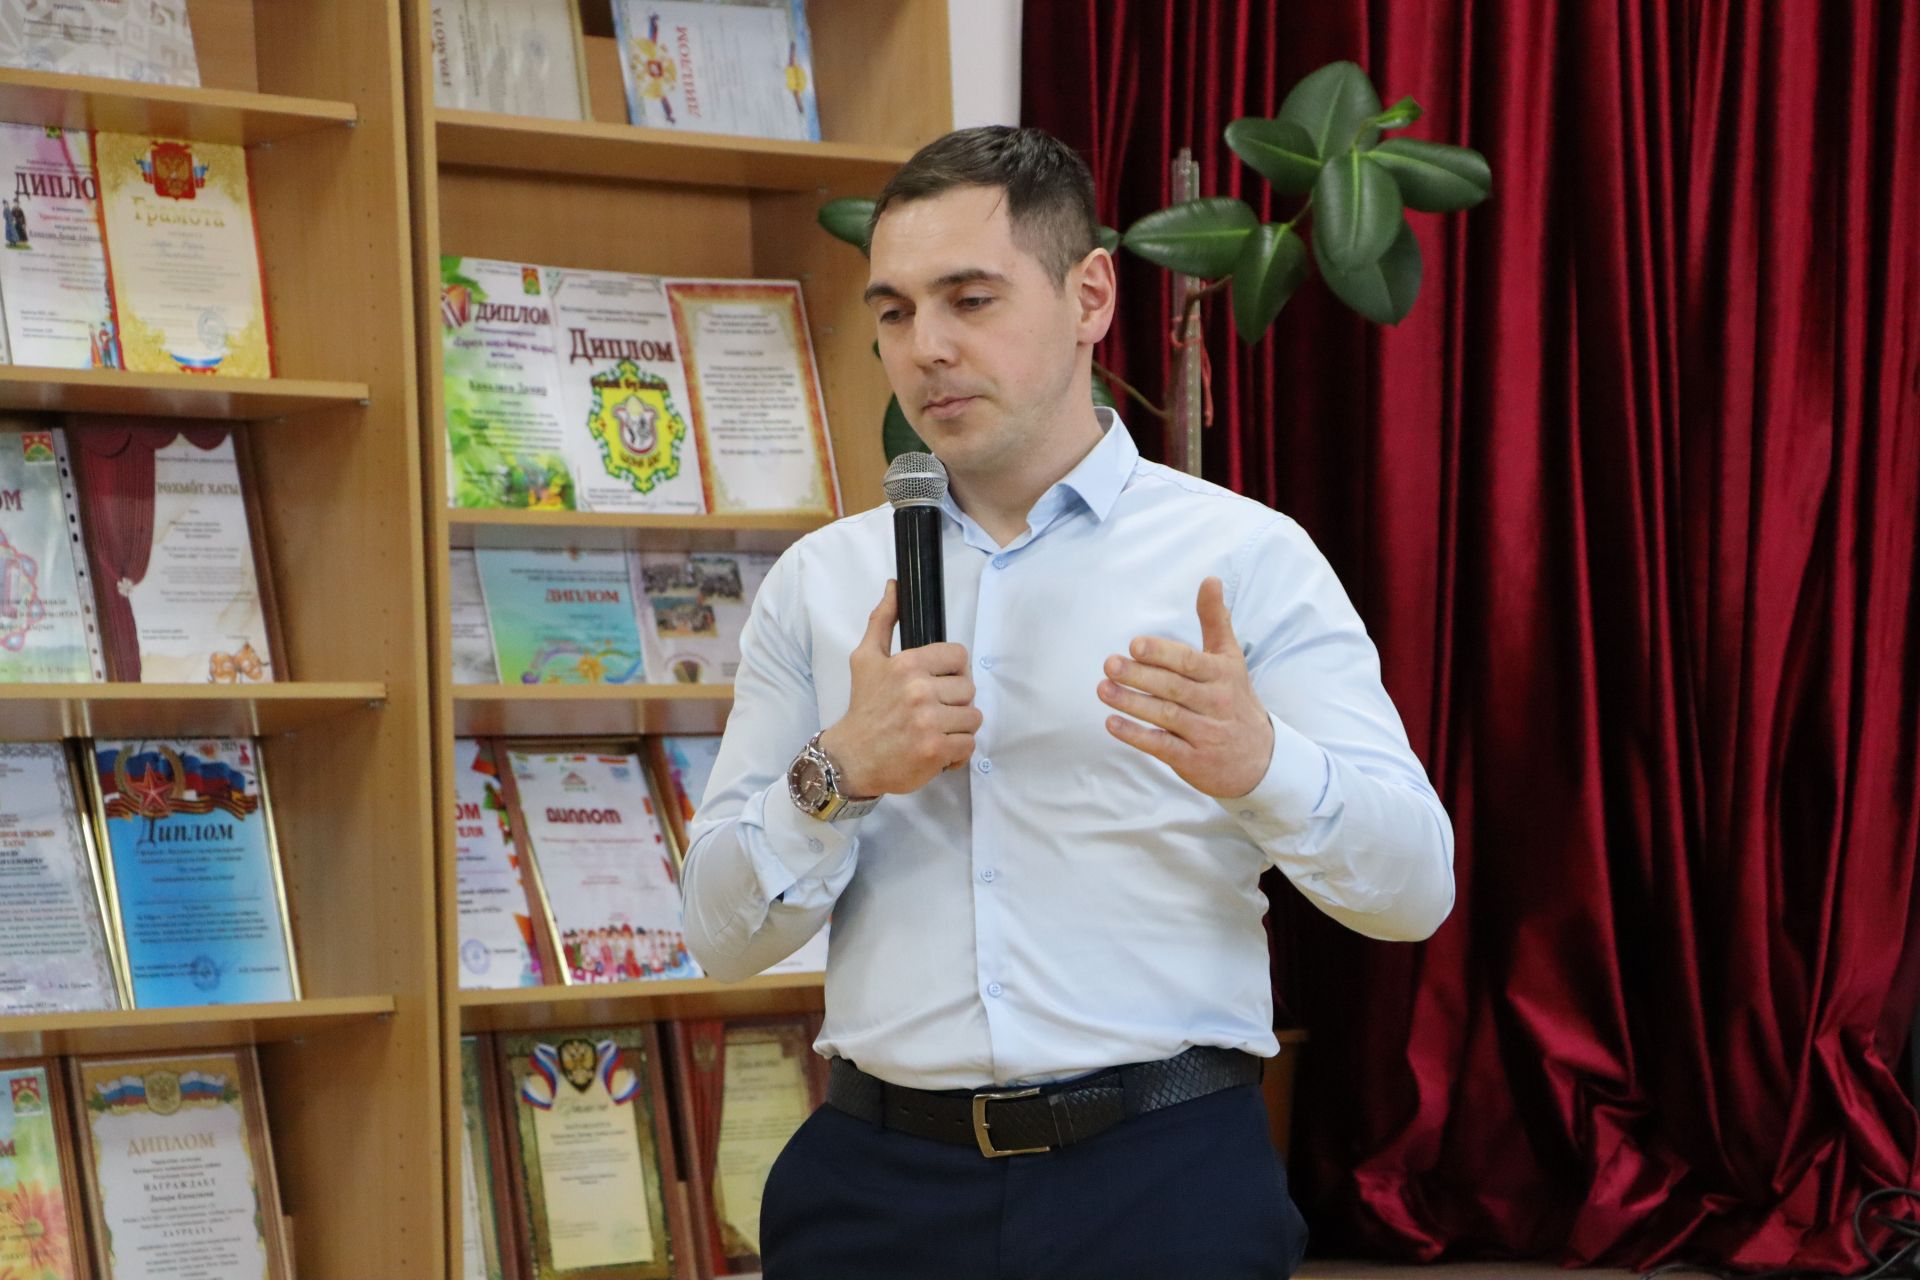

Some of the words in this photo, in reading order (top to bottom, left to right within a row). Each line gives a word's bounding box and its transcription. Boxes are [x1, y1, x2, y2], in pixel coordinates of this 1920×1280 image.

[676, 25, 702, 118] ДИПЛОМ
[131, 196, 225, 229] Грамота
[136, 816, 234, 847] Диплом
[128, 1133, 215, 1156] ДИПЛОМ
